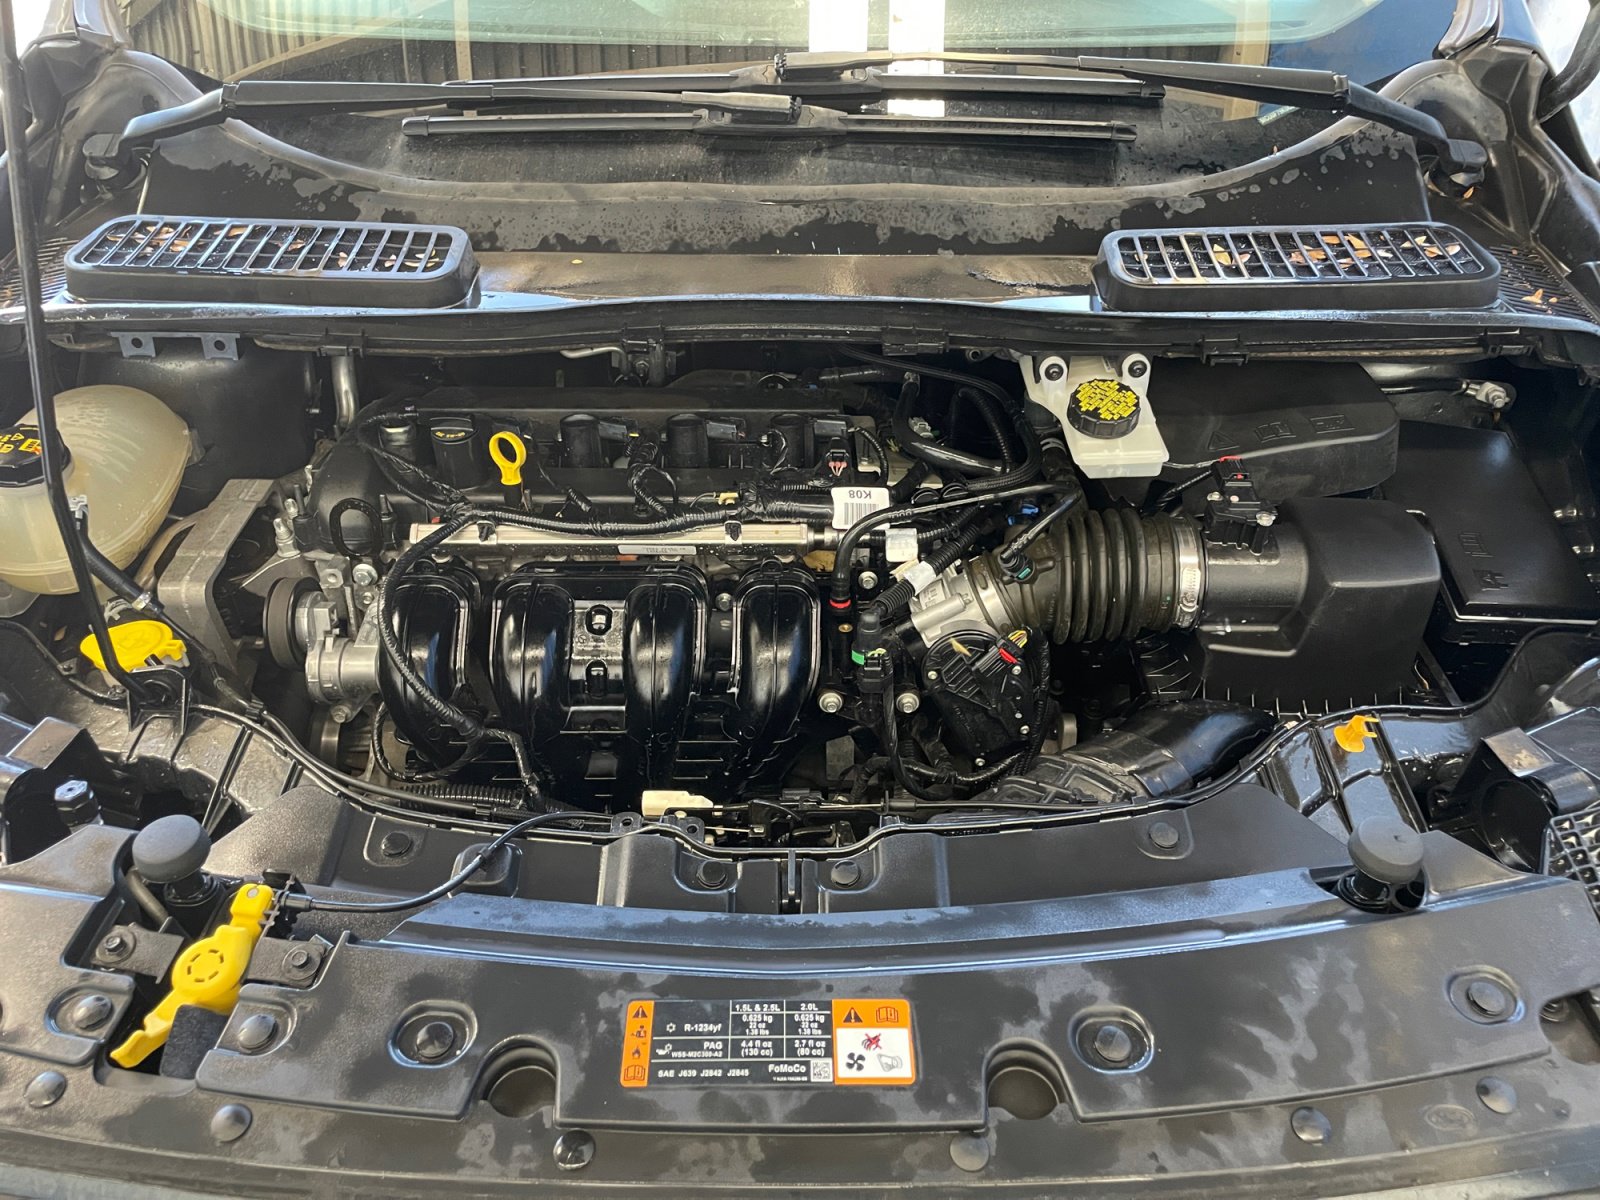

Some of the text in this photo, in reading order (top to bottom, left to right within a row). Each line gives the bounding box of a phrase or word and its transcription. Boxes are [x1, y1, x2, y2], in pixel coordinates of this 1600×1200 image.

[848, 489, 872, 499] K08
[735, 1004, 752, 1012] 1.5L
[763, 1003, 780, 1011] 2.5L
[800, 1003, 818, 1011] 2.0L
[742, 1014, 773, 1023] 0.625 kg
[794, 1014, 825, 1023] 0.625 kg
[684, 1023, 722, 1033] R-1234yf
[703, 1041, 723, 1050] PAG
[741, 1040, 753, 1048] 4.4
[755, 1040, 761, 1048] fl
[794, 1040, 807, 1048] 2.7
[808, 1040, 814, 1048] fl
[741, 1048, 773, 1057] (130 cc)
[811, 1048, 825, 1057] cc)
[768, 1064, 806, 1073] FoMoCo
[658, 1069, 675, 1078] SAE
[678, 1069, 697, 1078] J639
